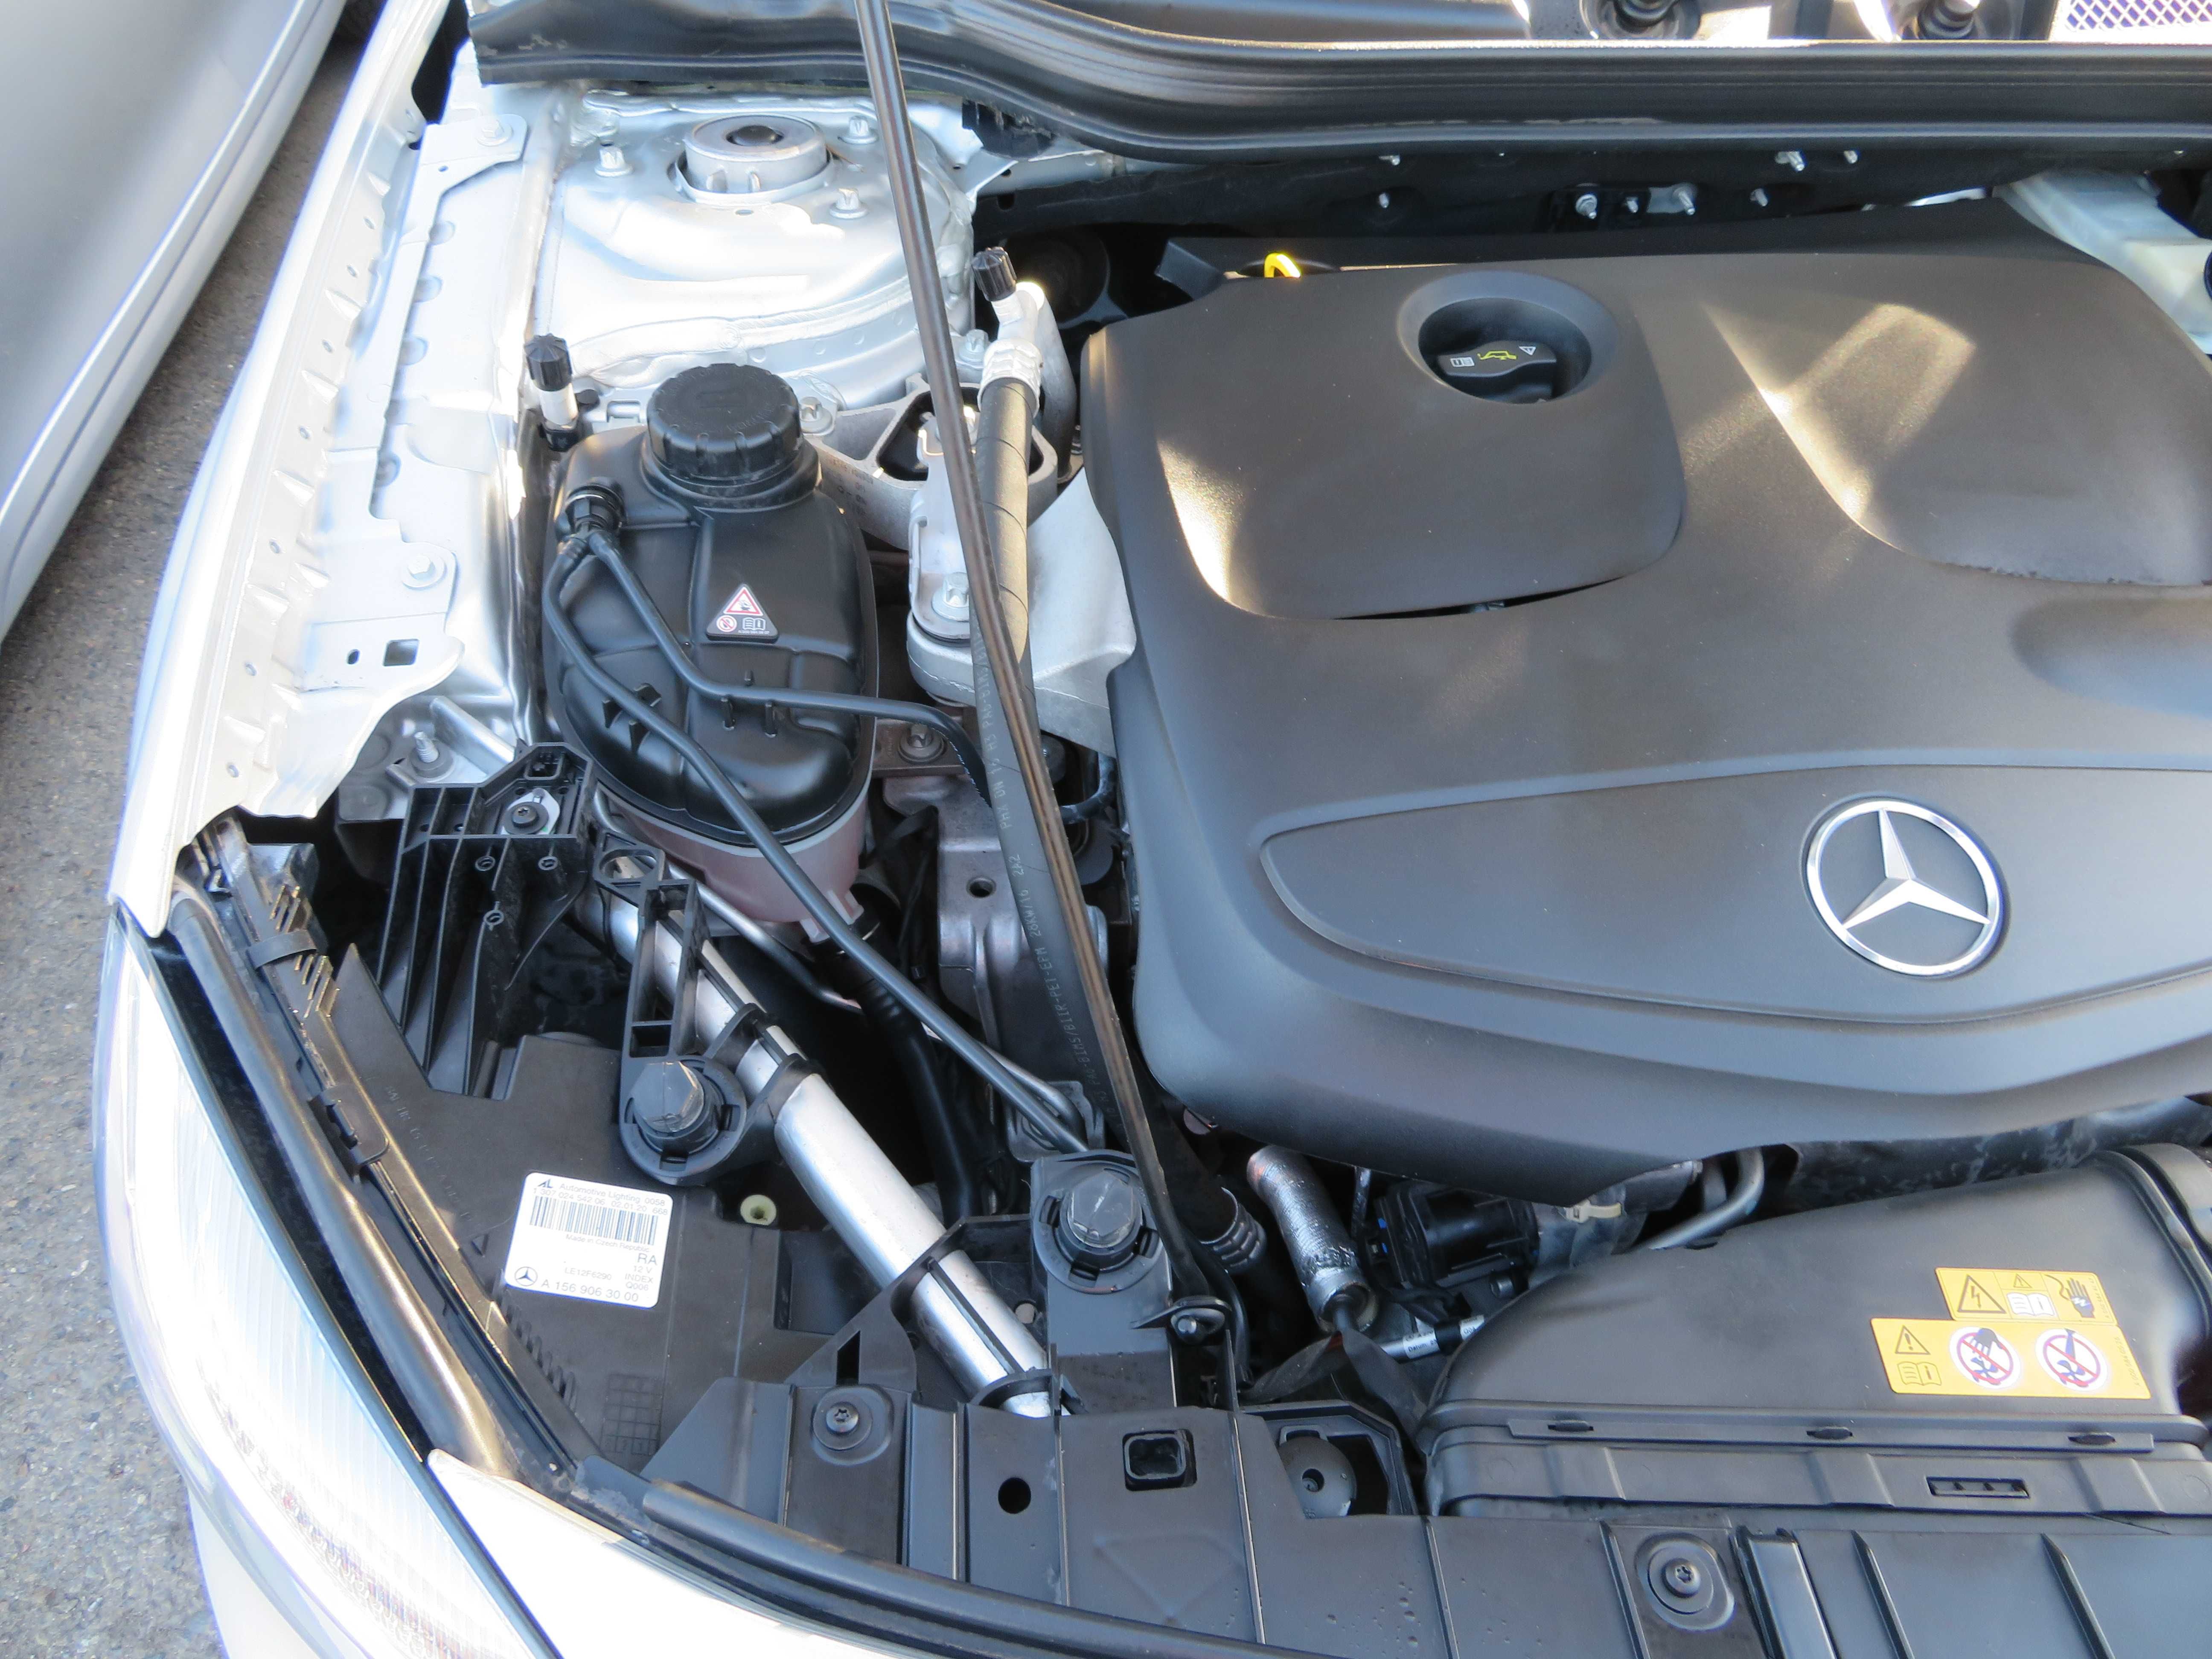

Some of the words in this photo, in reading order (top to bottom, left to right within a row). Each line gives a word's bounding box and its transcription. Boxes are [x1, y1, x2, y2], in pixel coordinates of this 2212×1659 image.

[993, 781, 1007, 799] DN
[1018, 888, 1042, 938] 28KW/16
[558, 1191, 574, 1199] 024
[594, 1197, 605, 1205] 06
[611, 1200, 647, 1212] 02.01.20
[652, 1207, 668, 1215] 668
[559, 1183, 606, 1196] Automotive
[608, 1191, 640, 1203] Lighting
[645, 1197, 666, 1207] 0058
[566, 1234, 585, 1243] Made
[595, 1239, 618, 1247] Czech
[620, 1242, 651, 1253] Republic
[637, 1253, 658, 1266] RA
[564, 1267, 612, 1281] LE12F6290
[625, 1273, 654, 1284] INDEX
[541, 1279, 550, 1288] A
[555, 1281, 576, 1292] 156
[580, 1285, 602, 1297] 906
[605, 1289, 620, 1299] 30
[624, 1292, 639, 1302] 00
[626, 1281, 649, 1291] Q006
[1408, 1342, 1427, 1352] Datum
